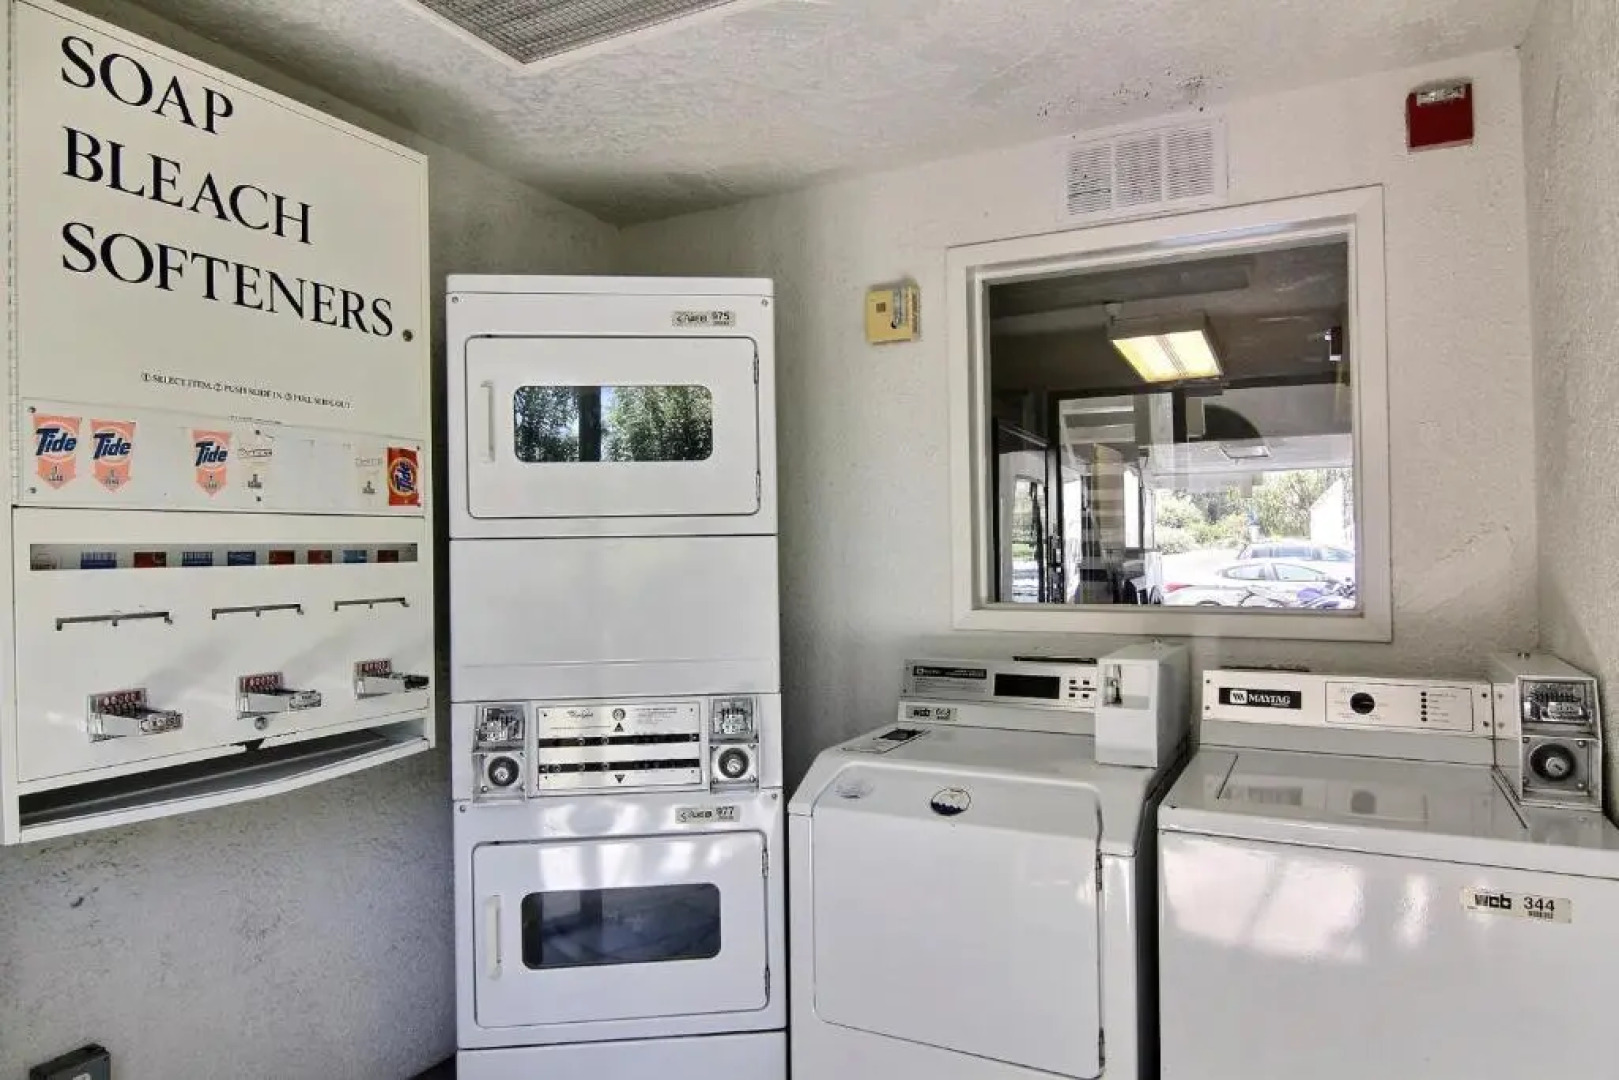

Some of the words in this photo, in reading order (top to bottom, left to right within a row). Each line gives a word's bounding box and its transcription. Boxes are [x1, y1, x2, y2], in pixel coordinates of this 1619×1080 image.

[61, 35, 234, 135] SOAP
[62, 126, 314, 245] BLEACH
[61, 222, 393, 338] SOFTENERS
[153, 374, 185, 386] SELECT
[224, 385, 247, 395] PUSH
[35, 427, 77, 456] Tide
[93, 432, 132, 460] Tide
[195, 441, 229, 467] Tide
[1248, 693, 1291, 704] MAYTAG
[1523, 896, 1555, 912] 344
